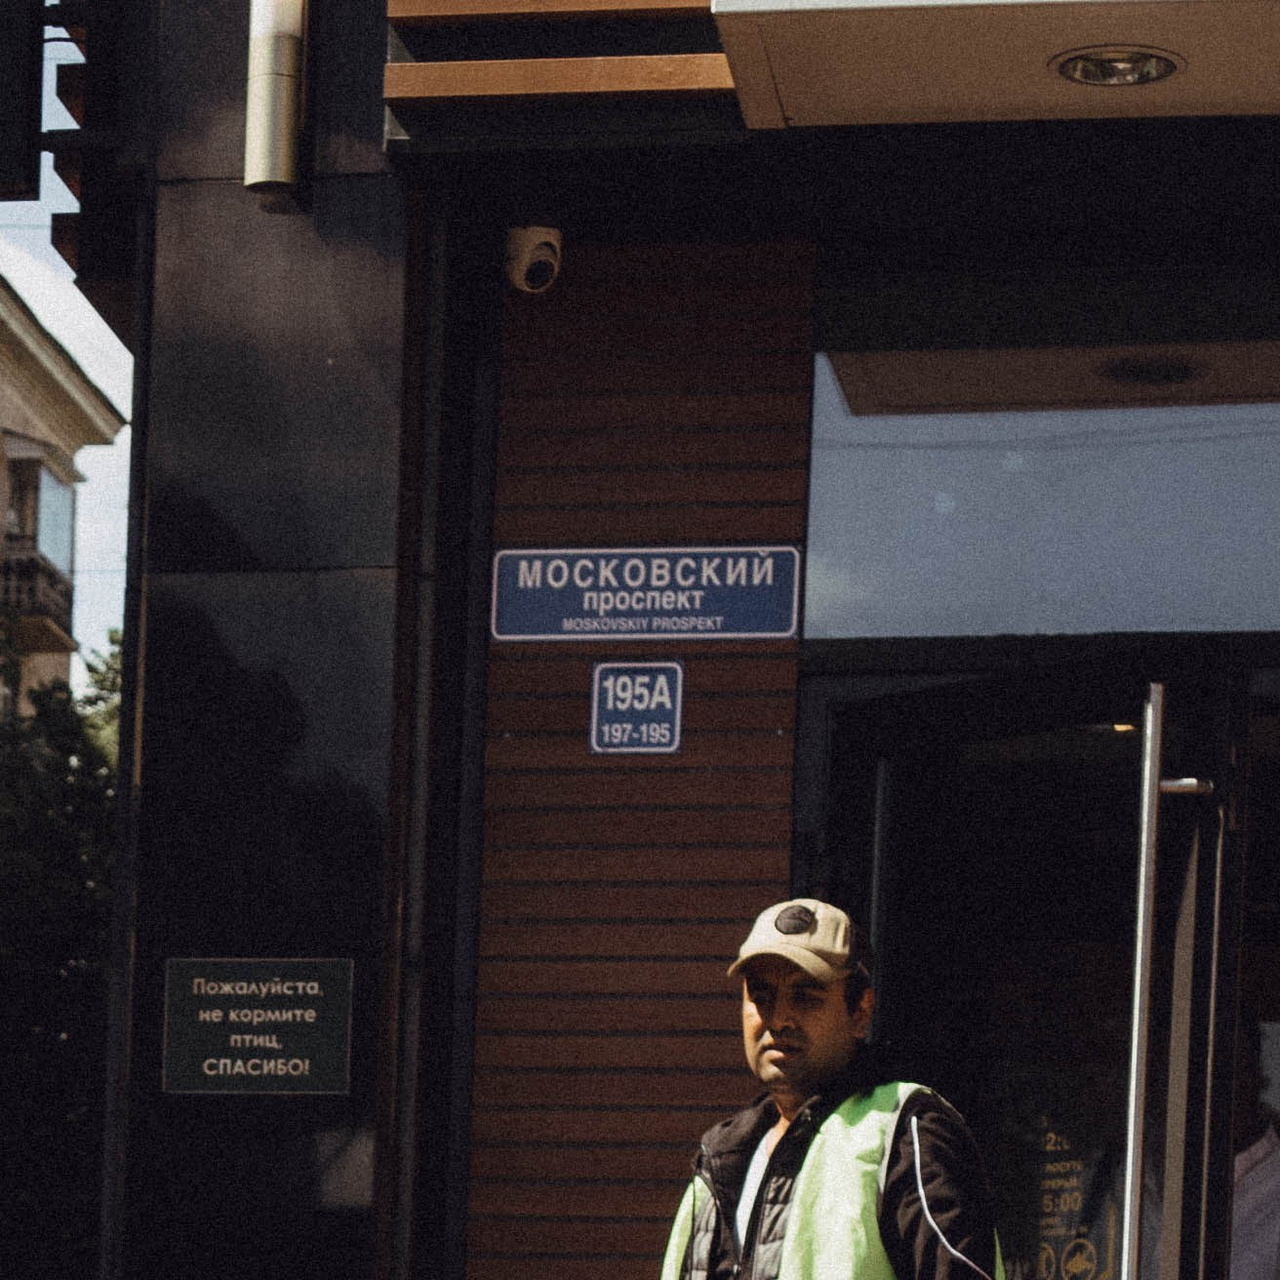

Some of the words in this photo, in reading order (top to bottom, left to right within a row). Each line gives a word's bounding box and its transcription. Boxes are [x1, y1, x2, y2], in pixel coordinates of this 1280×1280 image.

[517, 550, 775, 589] МОСКОВСКИЙ
[582, 589, 705, 616] проспект
[561, 616, 649, 632] MOSKOVSKIY
[651, 615, 725, 631] PROSPEKT
[601, 722, 672, 745] 197-195
[198, 1008, 223, 1023] не
[228, 1007, 318, 1026] кормите
[202, 1058, 310, 1076] СПАСИБО!
